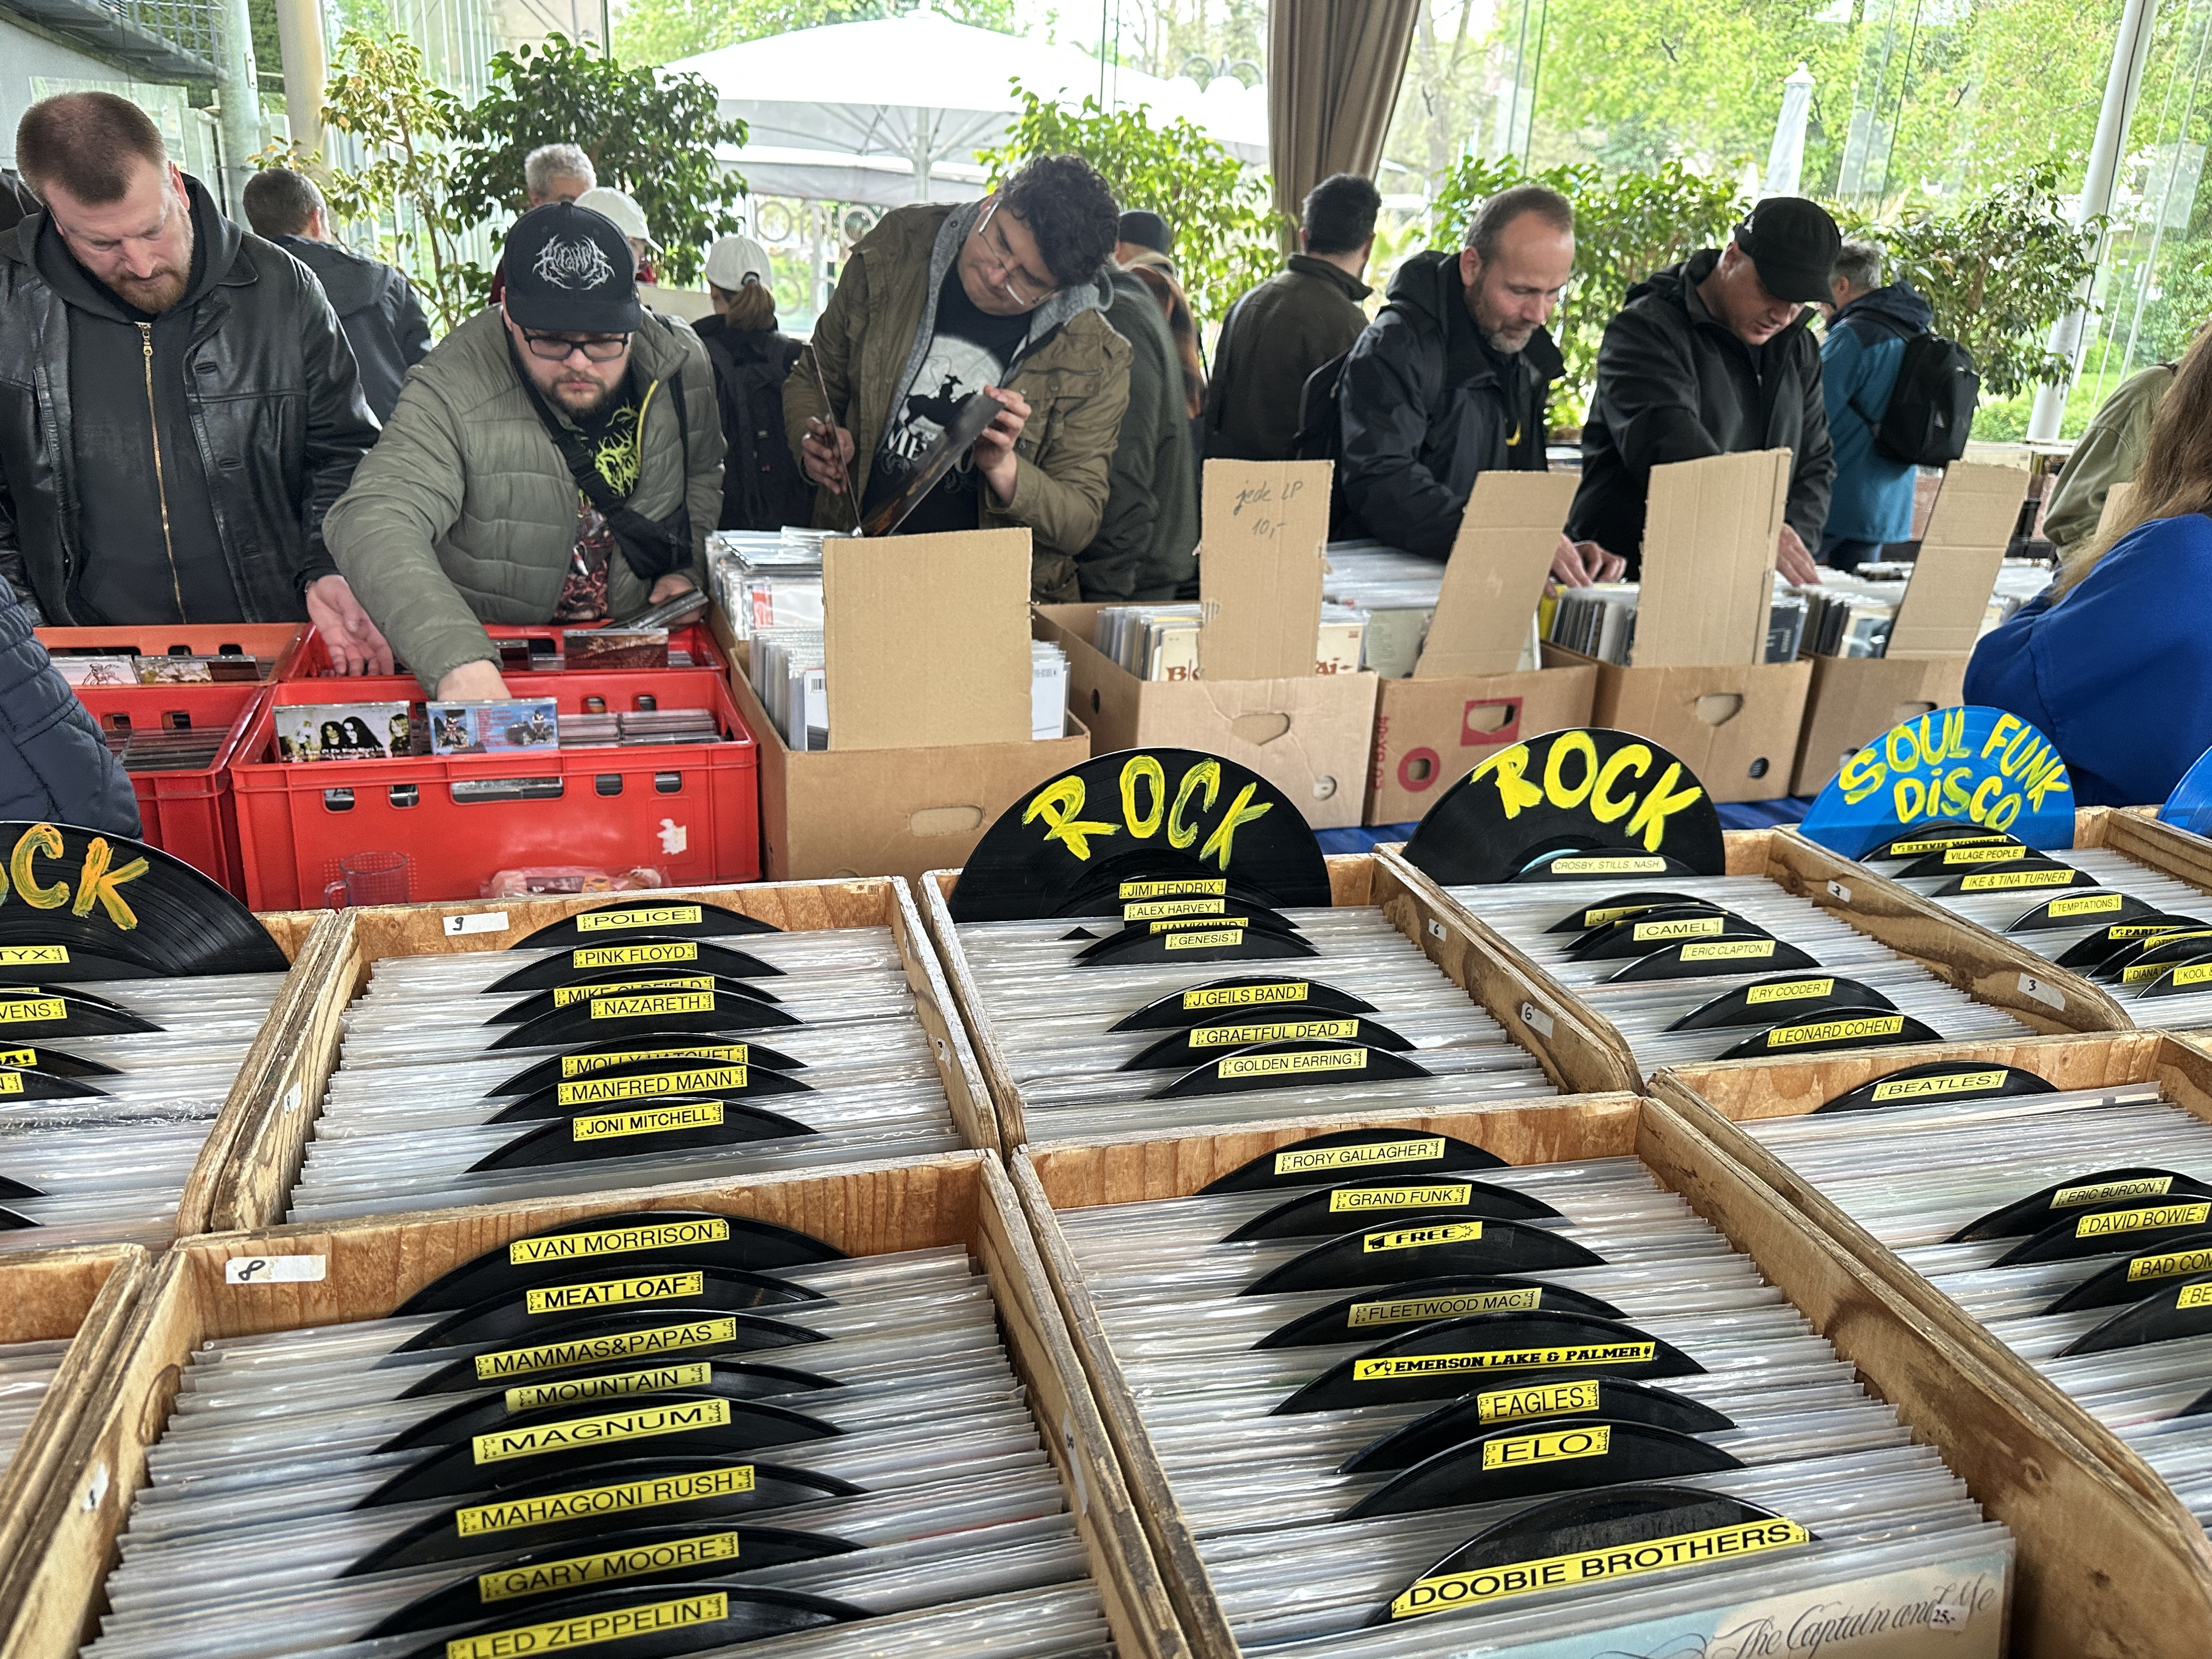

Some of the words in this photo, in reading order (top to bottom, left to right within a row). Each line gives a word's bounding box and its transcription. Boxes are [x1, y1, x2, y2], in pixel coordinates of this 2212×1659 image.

[1233, 481, 1271, 515] jede
[1282, 481, 1304, 500] LP
[1839, 708, 1971, 804] SOUL
[1980, 714, 2069, 813] FUNK
[1471, 730, 1702, 853] ROCK
[1022, 755, 1274, 871] ROCK
[1951, 850, 1984, 860] VILLAGE
[1987, 848, 2019, 859] PEOPLE
[0, 823, 149, 930] CK
[1968, 875, 1985, 887] IKE
[1987, 874, 1994, 885] &
[1996, 873, 2021, 885] TINA
[2023, 871, 2066, 884] TURNER
[1126, 883, 1153, 896] JIMI
[1156, 881, 1216, 895] HENDRIX
[1137, 904, 1163, 916] ALEX
[1165, 901, 1212, 915] HARVEY
[2057, 899, 2113, 912] TEMPTATIONS
[594, 910, 686, 926] POLICE
[1179, 933, 1229, 946] GENESIS
[1433, 924, 1440, 935] 6
[1646, 923, 1711, 936] CAMEL
[585, 950, 624, 964] PINK
[629, 945, 685, 961] FLOYD
[1691, 945, 1714, 957] ERIC
[1717, 943, 1763, 955] CLAPTON
[2133, 967, 2158, 980] DIANA
[2184, 969, 2206, 979] KOOL
[1759, 987, 1771, 998] RY
[1774, 983, 1820, 996] COODER
[2029, 979, 2036, 991] 3
[605, 996, 700, 1015] NAZARETH
[1193, 990, 1251, 1007] J.GEILS
[1254, 986, 1296, 1002] BAND
[1525, 1006, 1532, 1020] 6
[1206, 1024, 1291, 1044] GRAETFUL
[1295, 1022, 1339, 1038] DEAD
[1777, 1024, 1841, 1043] LEONARD
[1844, 1019, 1892, 1035] COHEN
[1234, 1056, 1289, 1073] GOLDEN
[1292, 1053, 1352, 1068] EARRING
[572, 1079, 669, 1101] MANFRED
[675, 1071, 732, 1090] MANN
[1889, 1075, 1991, 1095] BEATLES
[586, 1118, 624, 1134] JONI
[629, 1109, 710, 1128] MITCHELL
[1293, 1150, 1338, 1169] RORY
[1340, 1144, 1427, 1164] GALLAGHER
[1348, 1190, 1406, 1206] GRAND
[1410, 1188, 1453, 1204] FUNK
[2067, 1188, 2097, 1204] ERIC
[2100, 1183, 2155, 1199] BURDON
[2089, 1214, 2137, 1232] DAVID
[2142, 1207, 2195, 1227] BOWIE
[526, 1238, 575, 1259] VAN
[584, 1223, 714, 1252] MORRISON
[1395, 1228, 1457, 1244] FREE
[2140, 1258, 2175, 1276] BAD
[543, 1285, 614, 1309] MEAT
[622, 1277, 687, 1300] LOAF
[1369, 1297, 1478, 1320] FLEETWOOD
[1482, 1293, 1522, 1310] MAC
[494, 1324, 712, 1374] MAMMAS&PAPAS
[1393, 1356, 1486, 1373] EMERSON
[1491, 1352, 1543, 1366] LAKE
[1547, 1351, 1559, 1363] &
[1564, 1346, 1641, 1362] PALMER
[537, 1369, 679, 1404] MOUNTAIN
[1493, 1387, 1584, 1418] EAGLES
[501, 1408, 702, 1453] MAGNUM
[1502, 1434, 1593, 1462] ELO
[482, 1487, 643, 1529] MAHAGONI
[653, 1472, 733, 1502] RUSH
[505, 1561, 591, 1593] GARY
[603, 1539, 717, 1576] MOORE
[1409, 1564, 1566, 1607] DOOBIE
[1581, 1523, 1791, 1578] BROTHERS
[471, 1632, 537, 1659] LED
[548, 1602, 702, 1647] ZEPPELIN
[1787, 1601, 1889, 1659] Captain
